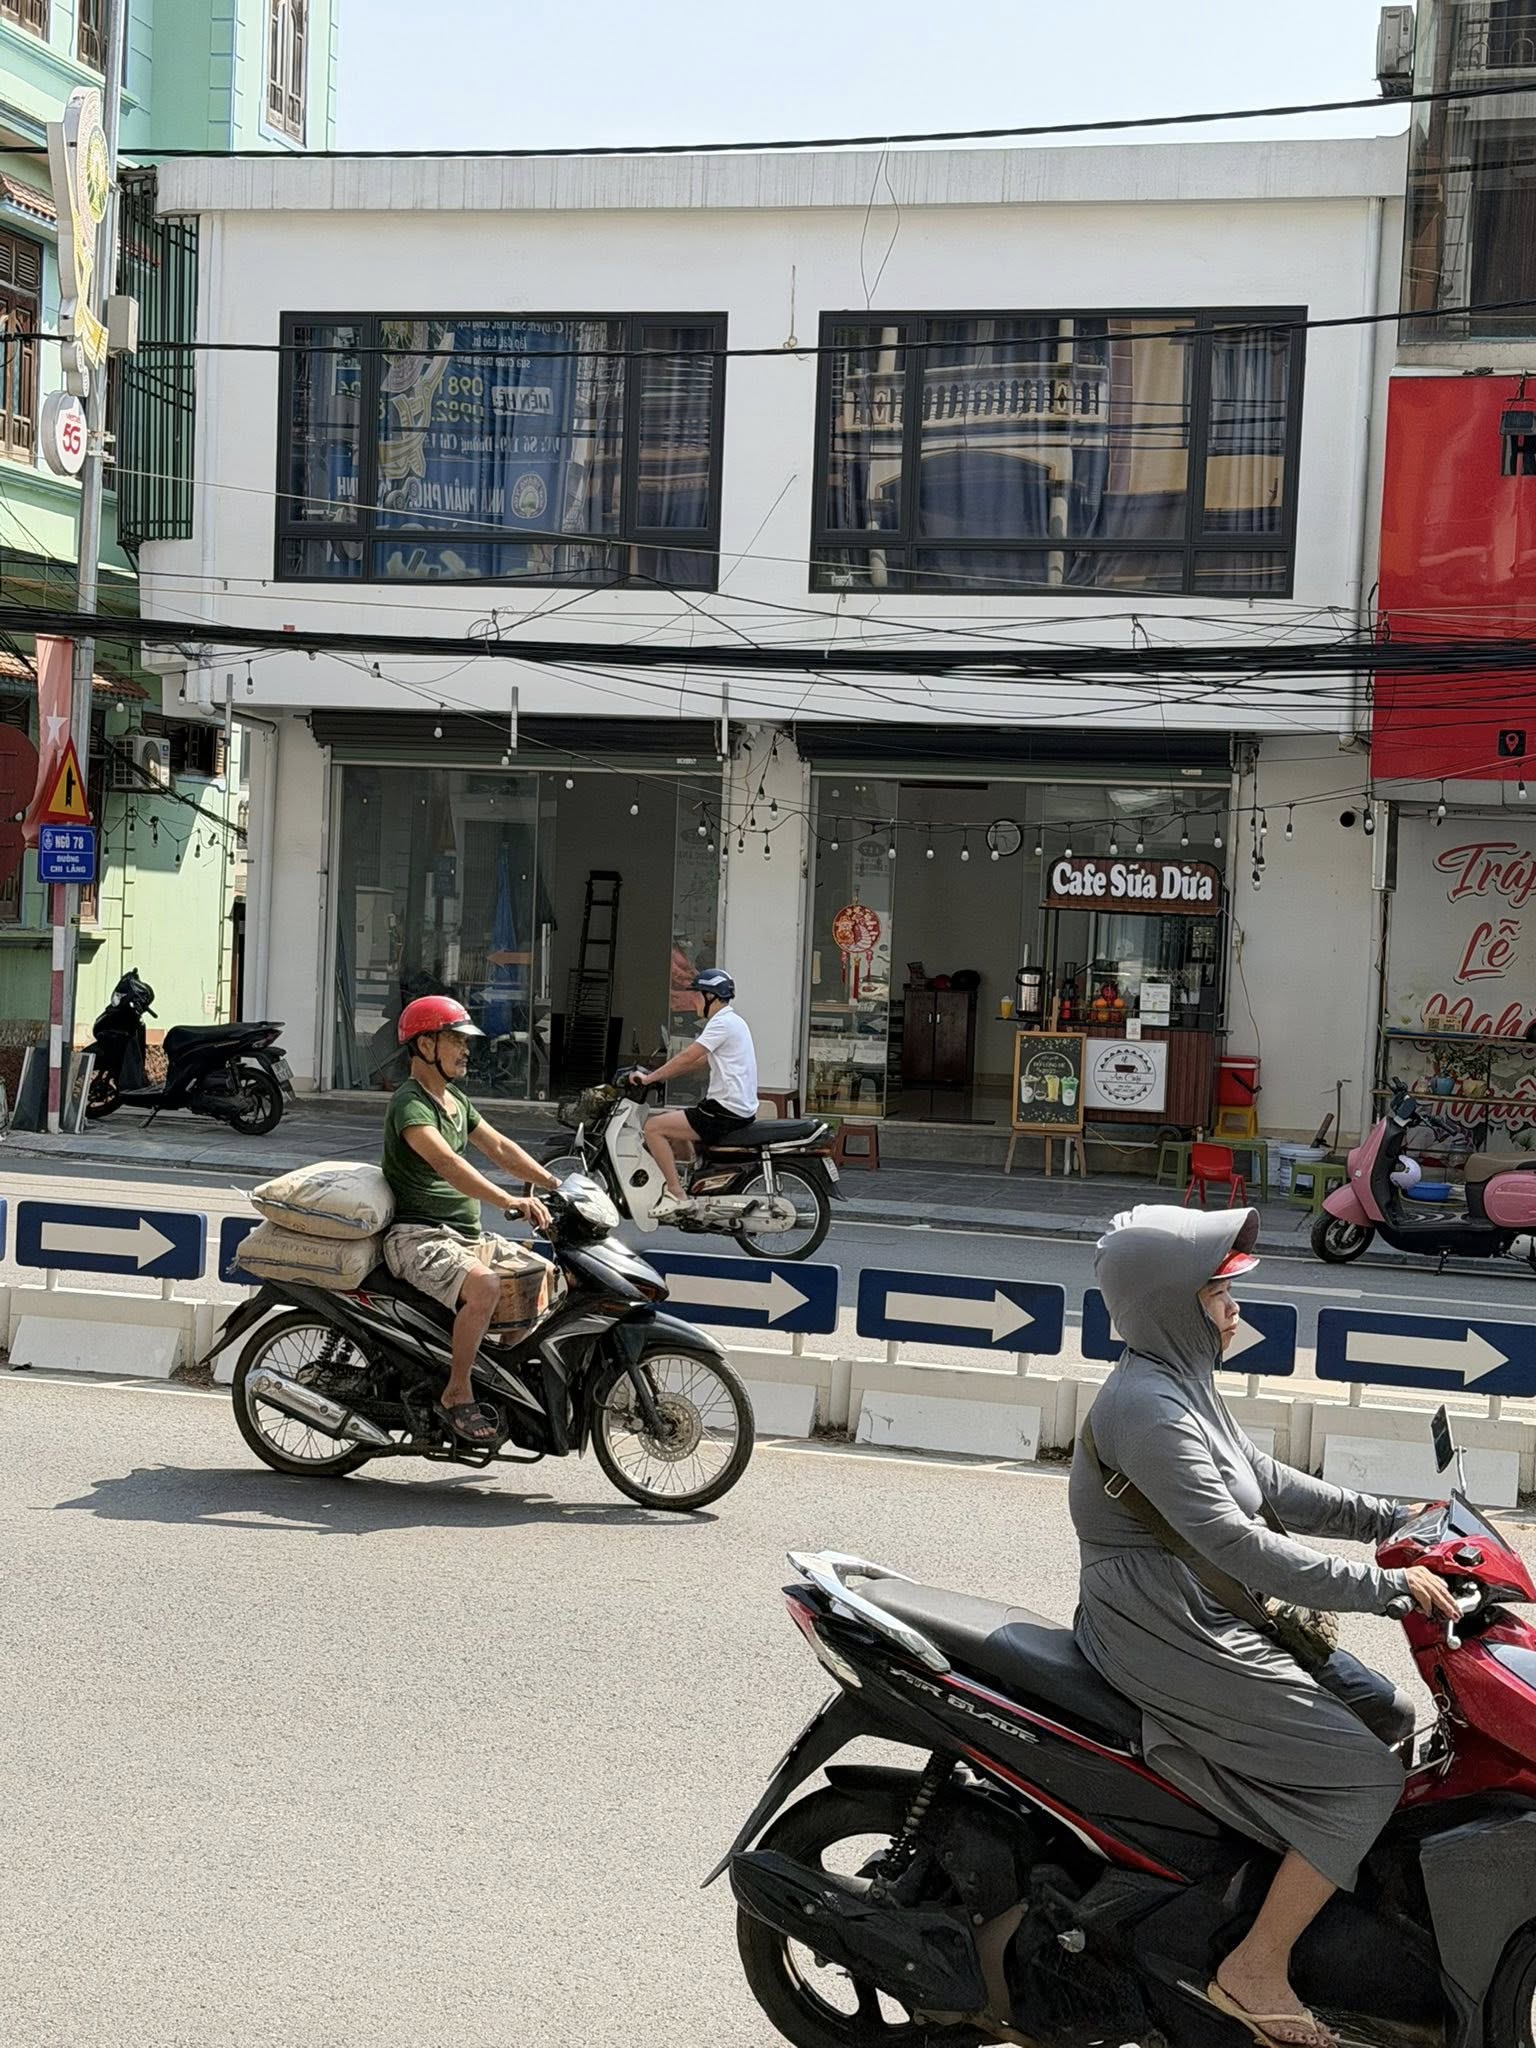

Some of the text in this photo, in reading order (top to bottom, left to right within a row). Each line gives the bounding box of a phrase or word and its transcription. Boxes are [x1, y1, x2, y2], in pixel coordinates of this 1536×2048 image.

[62, 422, 82, 455] 5G
[72, 836, 85, 850] 78
[50, 865, 63, 873] CHI
[1052, 861, 1213, 902] Cafe Sữa Dừa
[1457, 918, 1520, 980] Lễ
[889, 1665, 1040, 1745] AIR BLADE
